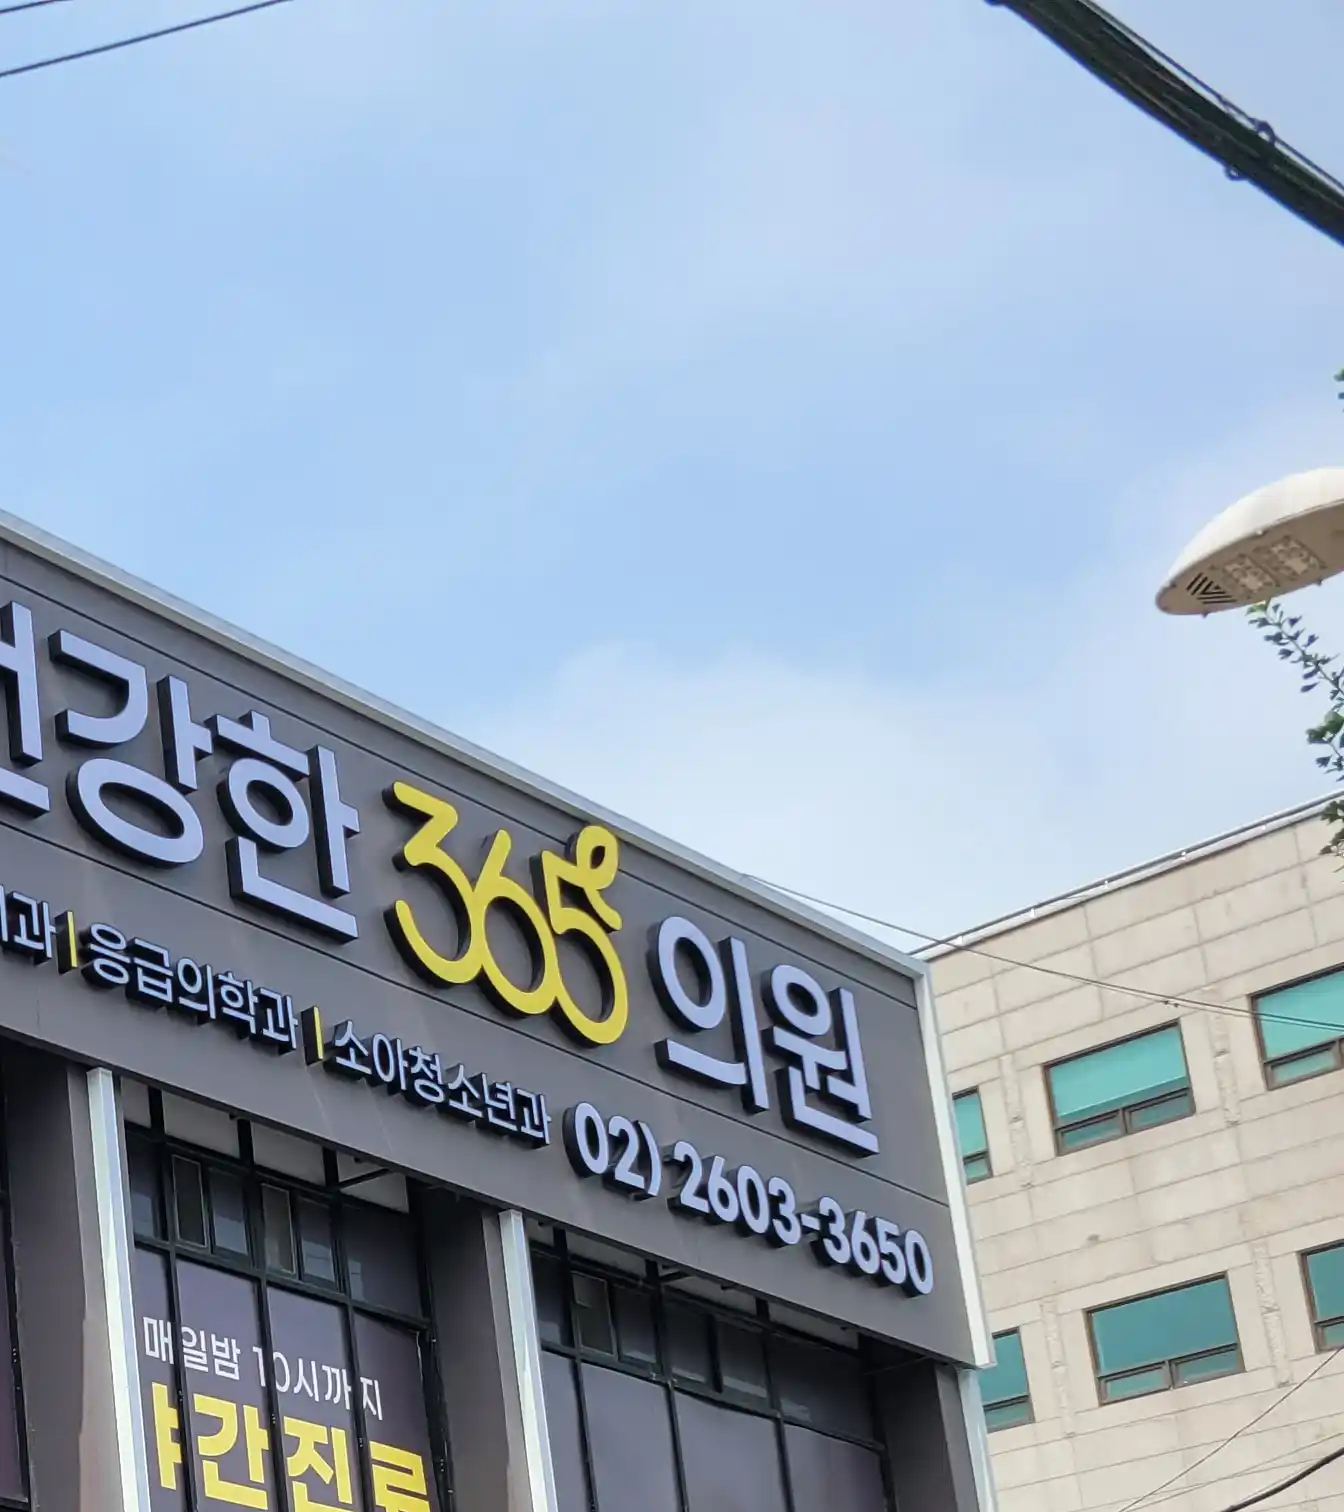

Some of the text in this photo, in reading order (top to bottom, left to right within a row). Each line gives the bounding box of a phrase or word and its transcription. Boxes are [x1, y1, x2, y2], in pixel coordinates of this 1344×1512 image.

[87, 922, 298, 1050] 응급의학과
[331, 1018, 551, 1146] 소아청소년과
[677, 1140, 934, 1297] 2603-3650
[387, 781, 628, 1044] 365
[651, 916, 880, 1157] 의원
[143, 1316, 383, 1421] 매일밤 10시까지
